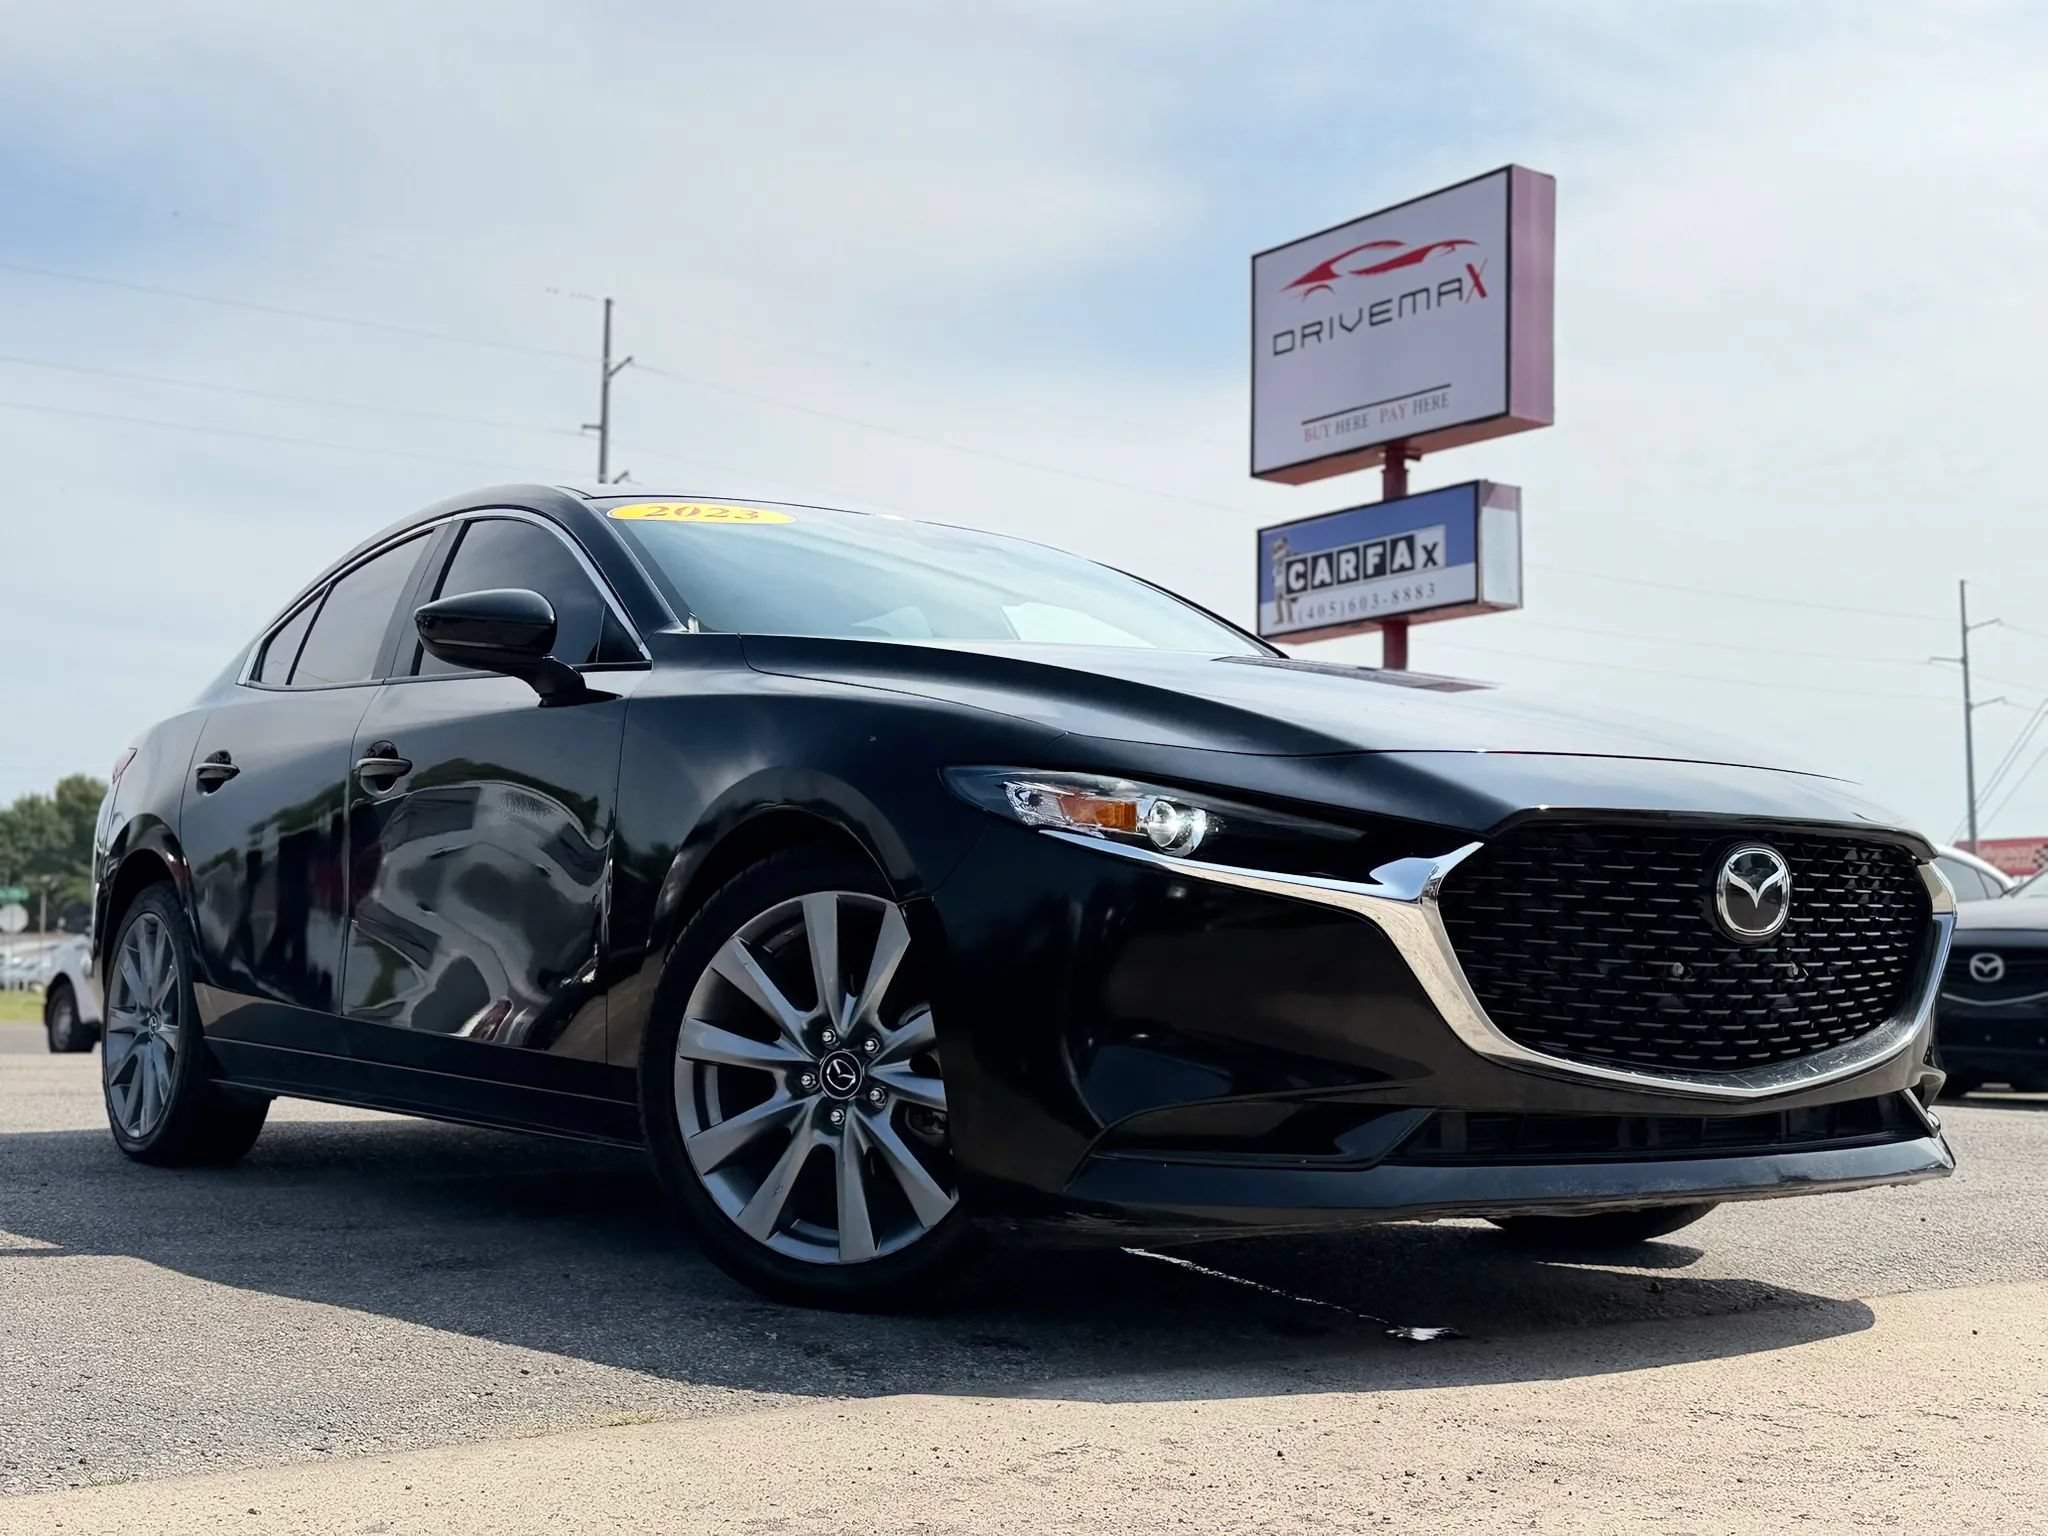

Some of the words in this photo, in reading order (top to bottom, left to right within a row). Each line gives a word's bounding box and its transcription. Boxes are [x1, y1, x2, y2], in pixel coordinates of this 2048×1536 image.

[1273, 257, 1488, 356] DRIVEMAX
[1304, 423, 1330, 443] BUY
[1335, 413, 1369, 436] HERE
[1379, 403, 1408, 424] PAY
[1413, 392, 1449, 416] HERE
[645, 506, 759, 520] 2023
